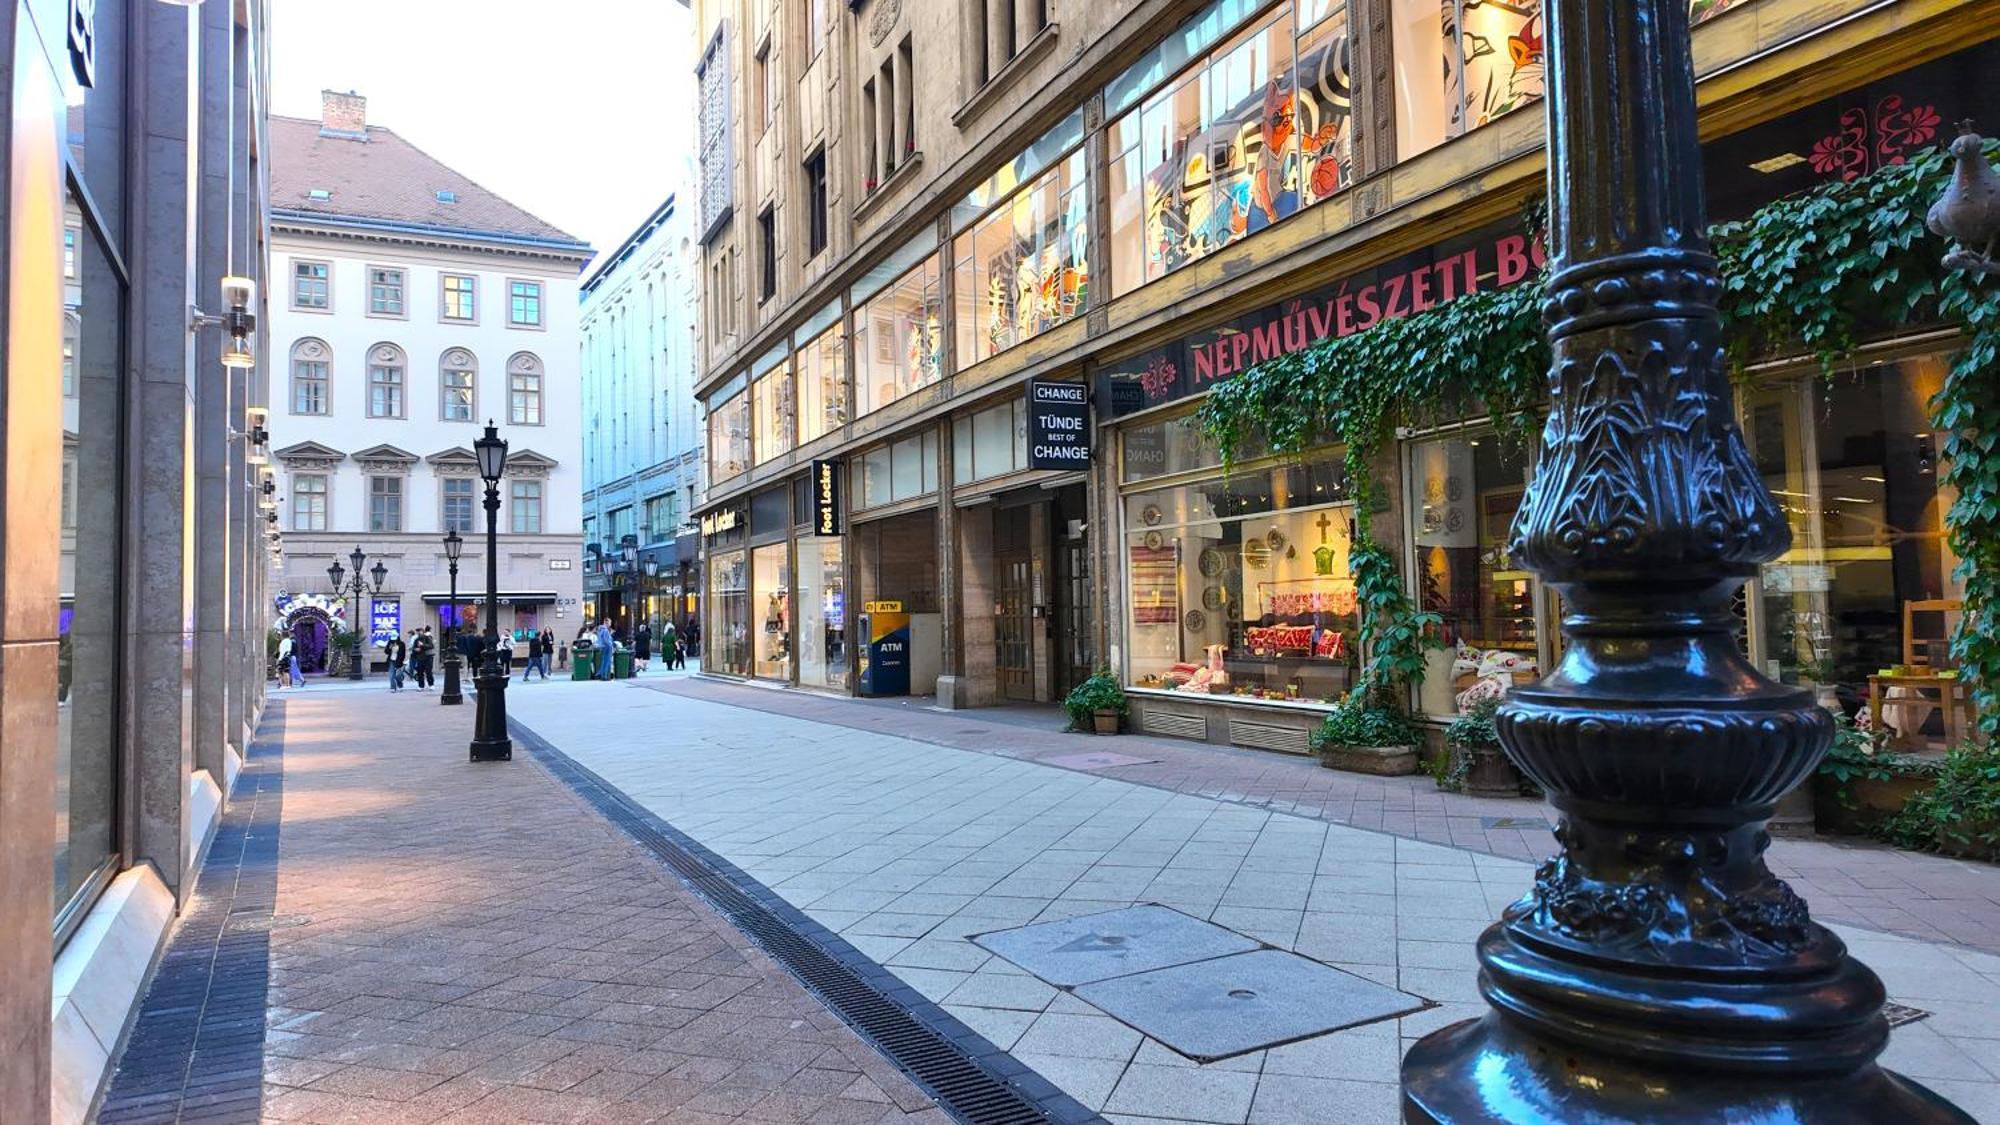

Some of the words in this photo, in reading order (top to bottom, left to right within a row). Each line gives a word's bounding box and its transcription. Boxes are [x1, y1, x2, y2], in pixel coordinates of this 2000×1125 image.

[1194, 249, 1478, 384] NÉPMŰVÉSZETI
[1037, 387, 1083, 400] CHANGE
[1038, 414, 1083, 430] TÜNDE
[1066, 434, 1076, 442] OF
[1034, 445, 1089, 460] CHANGE
[820, 463, 832, 504] Locker
[821, 507, 833, 533] Foot
[374, 603, 398, 614] ICE
[374, 617, 397, 625] BAR
[880, 643, 903, 652] ATM
